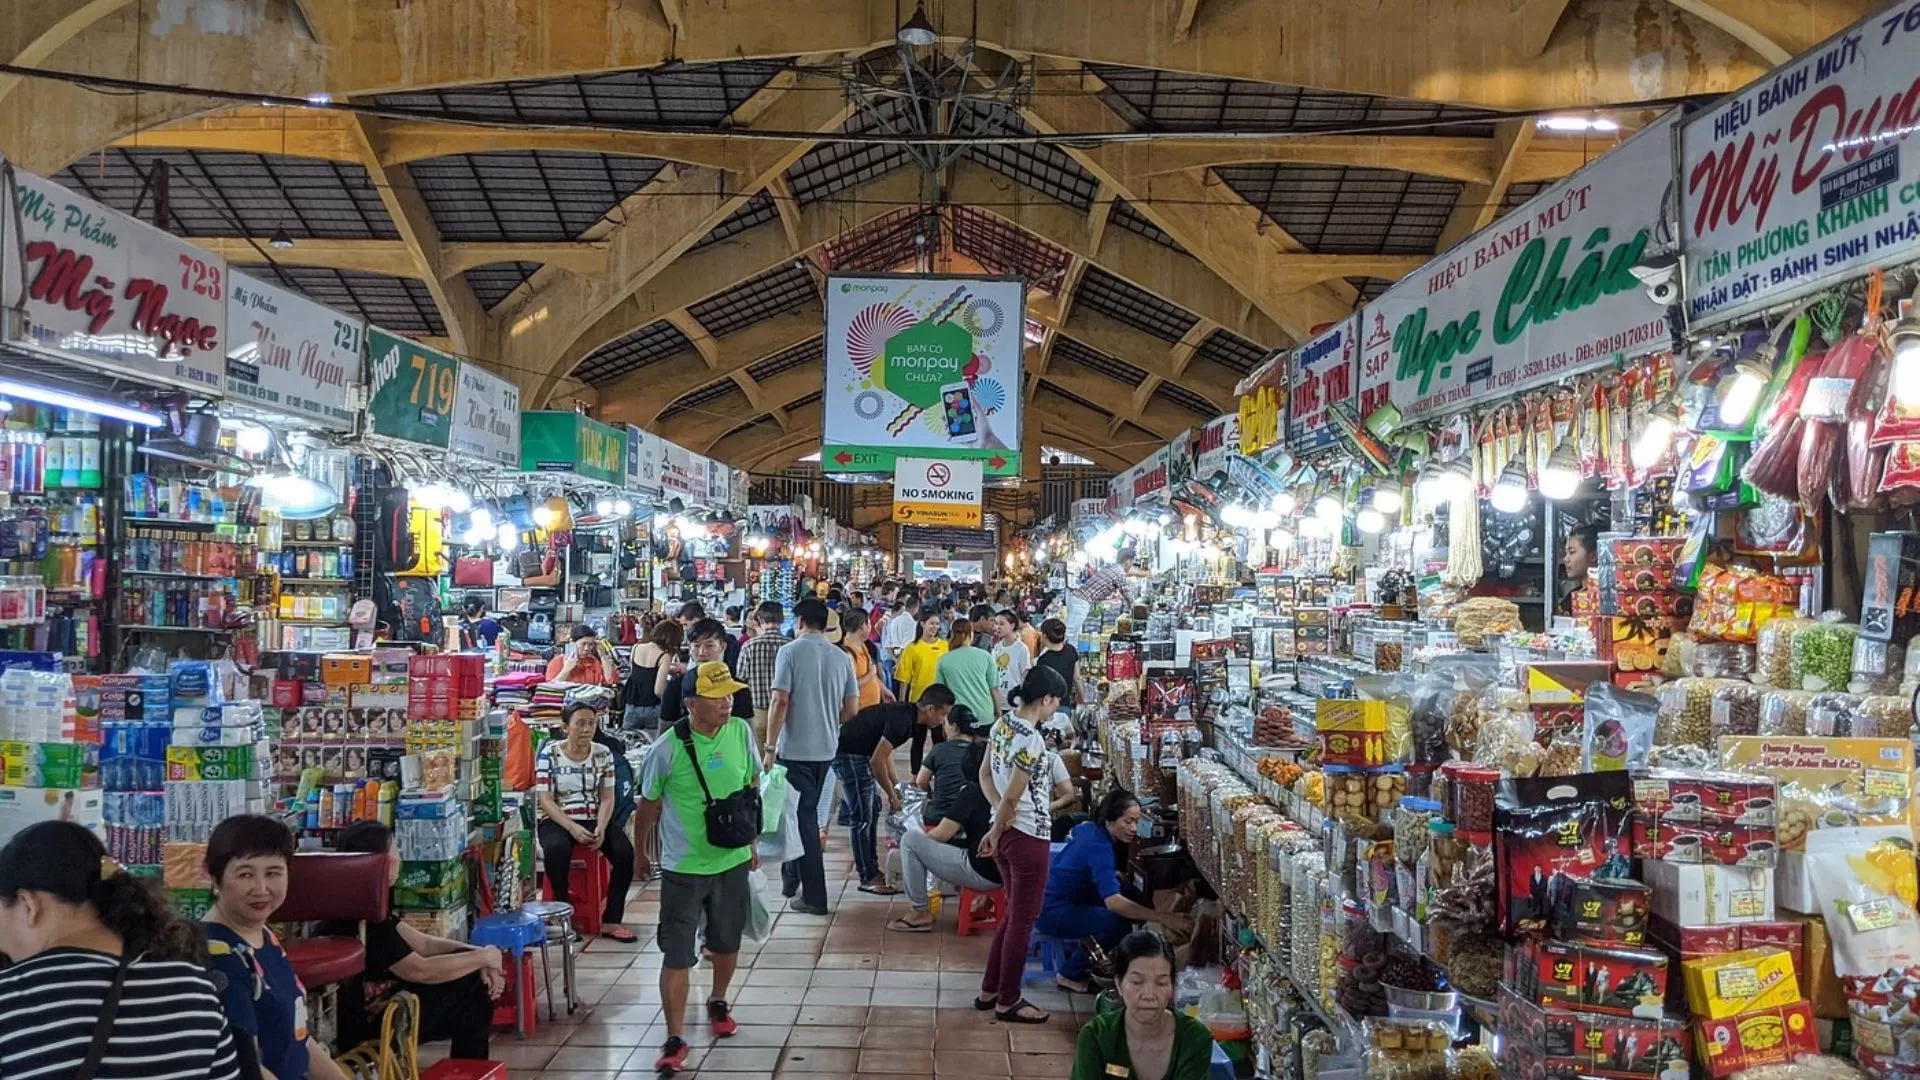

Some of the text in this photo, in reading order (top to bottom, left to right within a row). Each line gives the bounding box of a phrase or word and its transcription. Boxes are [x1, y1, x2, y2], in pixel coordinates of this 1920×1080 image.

[1714, 98, 1751, 141] HIỆU
[1757, 65, 1808, 116] BÁNH
[1815, 34, 1863, 84] MỨT
[1690, 128, 1781, 239] Mỹ
[16, 185, 58, 234] Mỹ
[1427, 185, 1592, 296] HIỆU BÁNH MỨT
[1692, 285, 1728, 315] NHẬN
[1771, 257, 1818, 286] BÁNH
[1824, 235, 1869, 266] SINH
[1875, 211, 1920, 248] NHẬ
[1738, 219, 1809, 270] PHƯƠNG
[26, 240, 116, 335] Mỹ
[179, 254, 222, 301] 723
[852, 283, 888, 294] monpay
[333, 319, 359, 354] 721
[1392, 306, 1482, 396] Ngọc
[410, 354, 455, 416] 719
[891, 354, 958, 371] monpay
[1365, 351, 1389, 380] SẠP
[854, 453, 879, 464] EXIT
[902, 488, 975, 501] NO SMOKING
[103, 676, 138, 686] Colgate
[403, 873, 430, 887] Spring
[1554, 963, 1574, 974] G7
